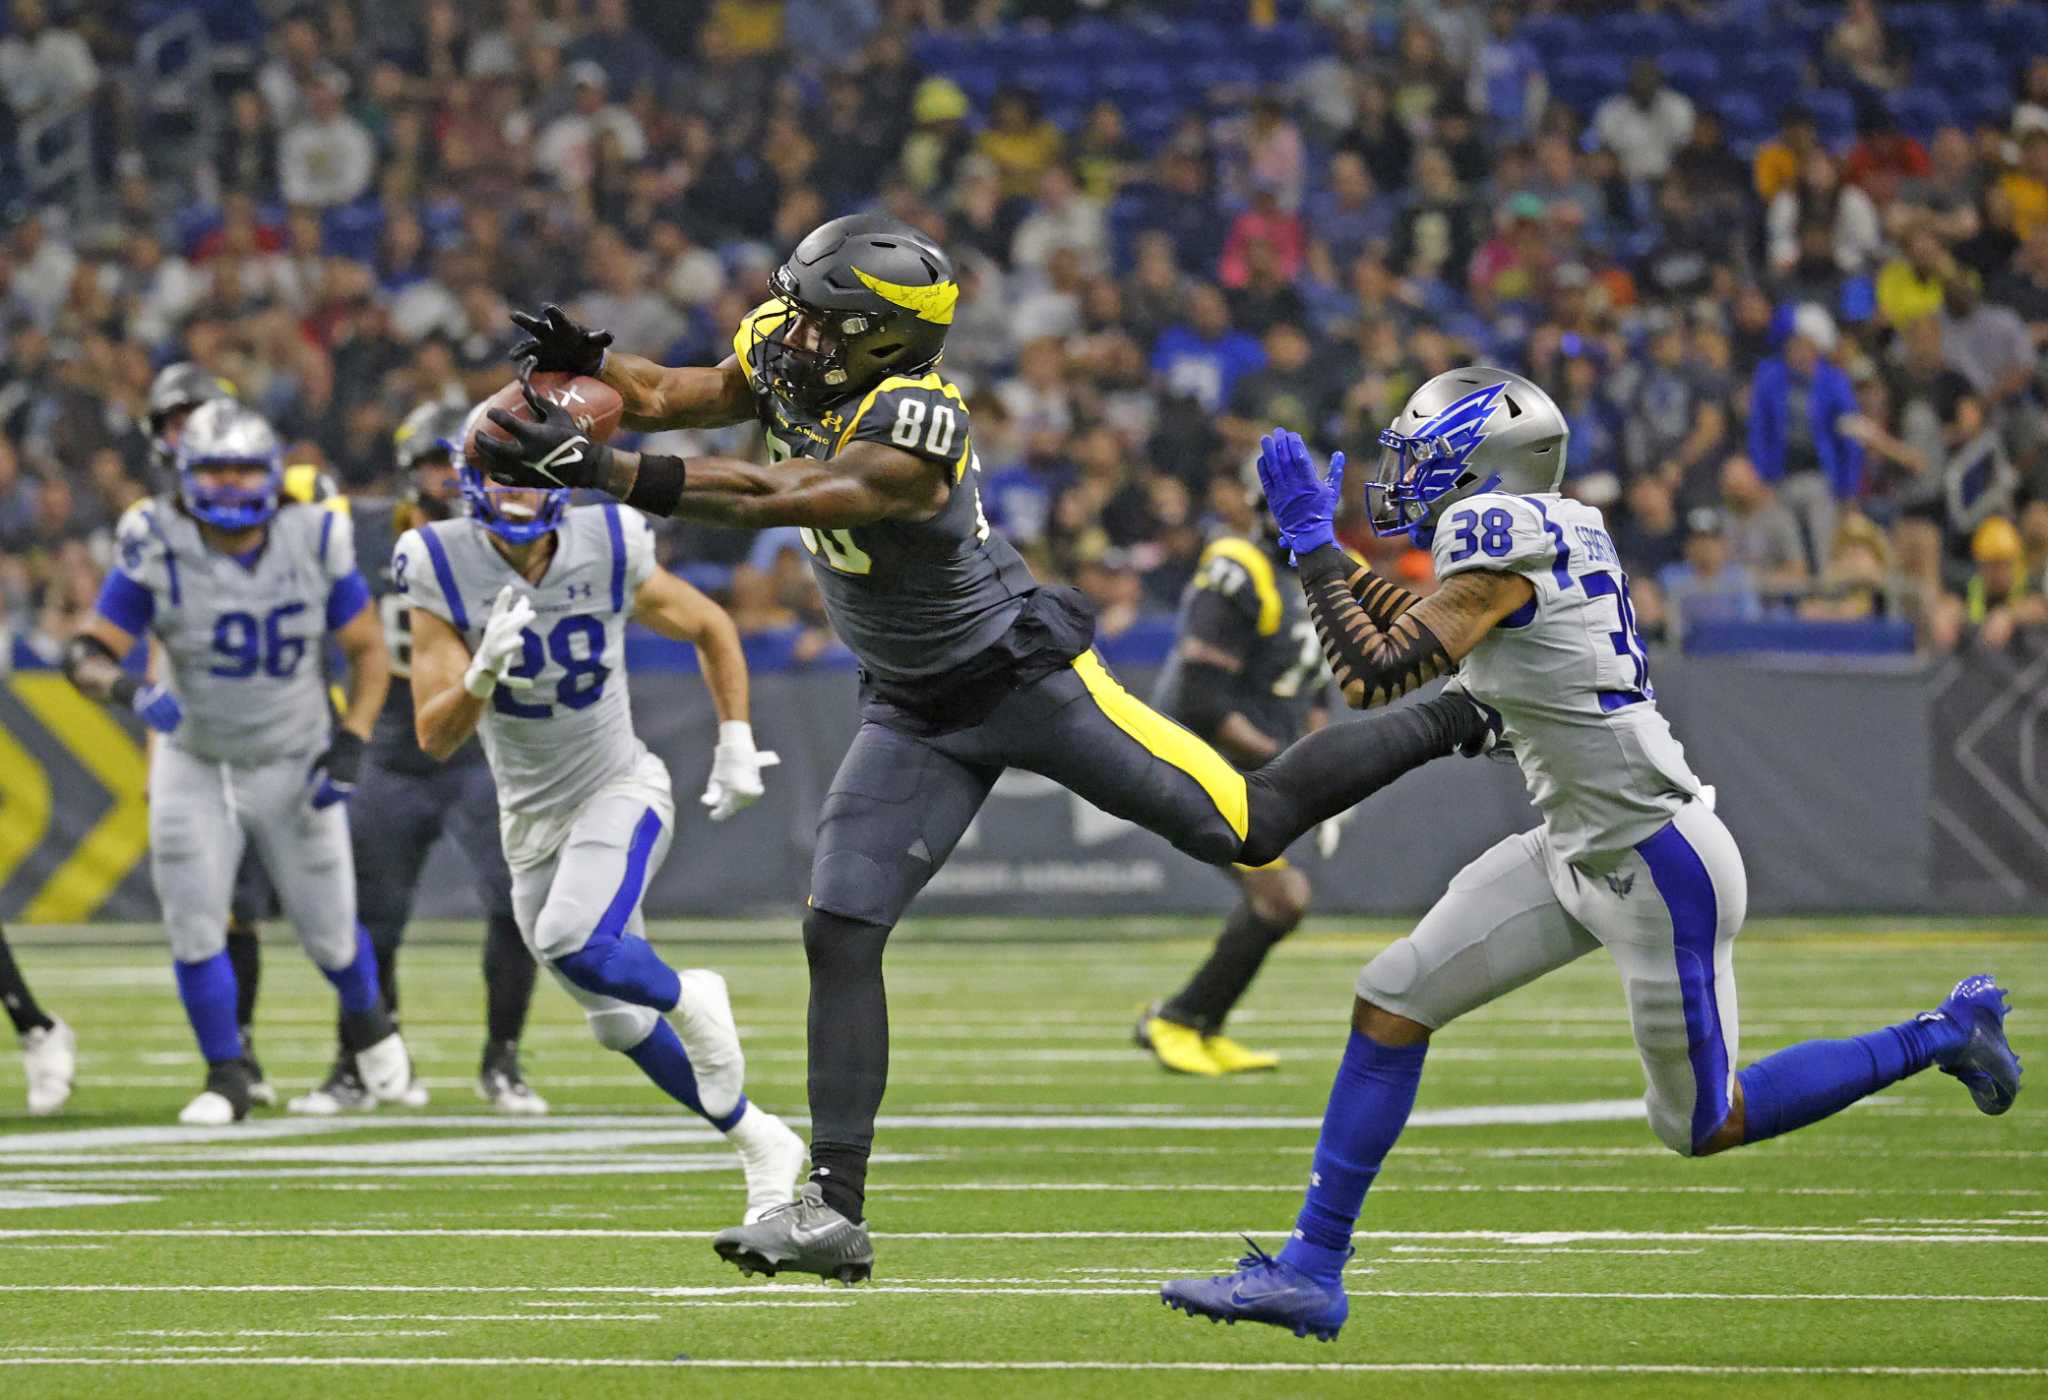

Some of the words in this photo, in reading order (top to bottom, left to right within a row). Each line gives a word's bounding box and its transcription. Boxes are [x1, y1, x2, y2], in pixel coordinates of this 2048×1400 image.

[891, 398, 956, 456] 80
[1450, 507, 1514, 562] 38
[208, 601, 306, 679] 96
[492, 614, 611, 719] 28
